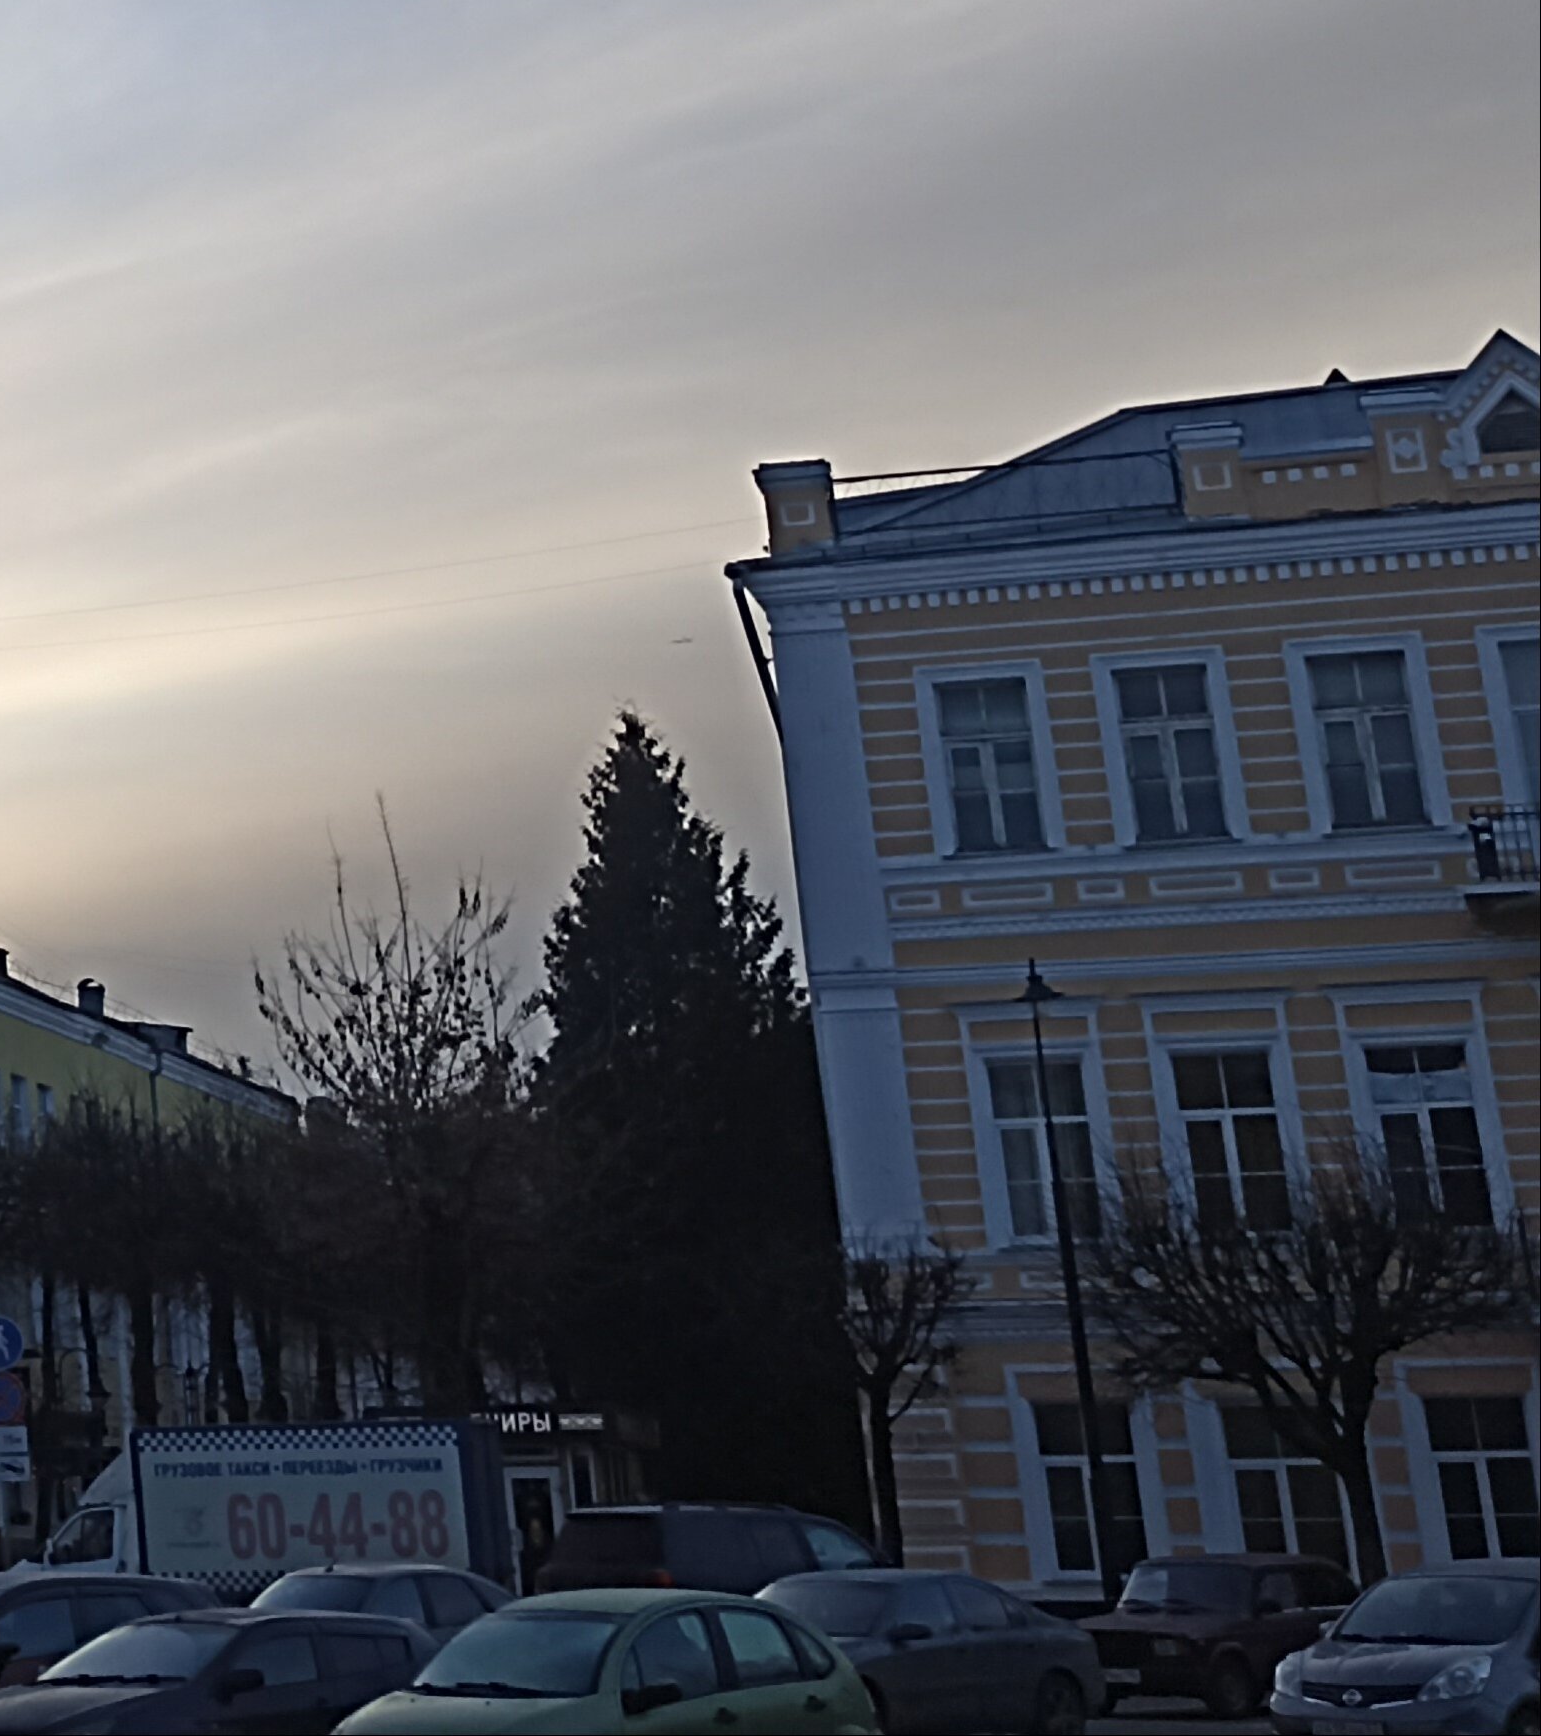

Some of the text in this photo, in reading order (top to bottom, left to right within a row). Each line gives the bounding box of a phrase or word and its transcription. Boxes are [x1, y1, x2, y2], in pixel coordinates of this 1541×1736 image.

[228, 1461, 271, 1477] ТАКСИ
[282, 1459, 358, 1475] ПЕРЕЕЗДЫ
[370, 1457, 443, 1474] ГРУЗЧИКИ
[226, 1488, 450, 1560] 60-44-88
